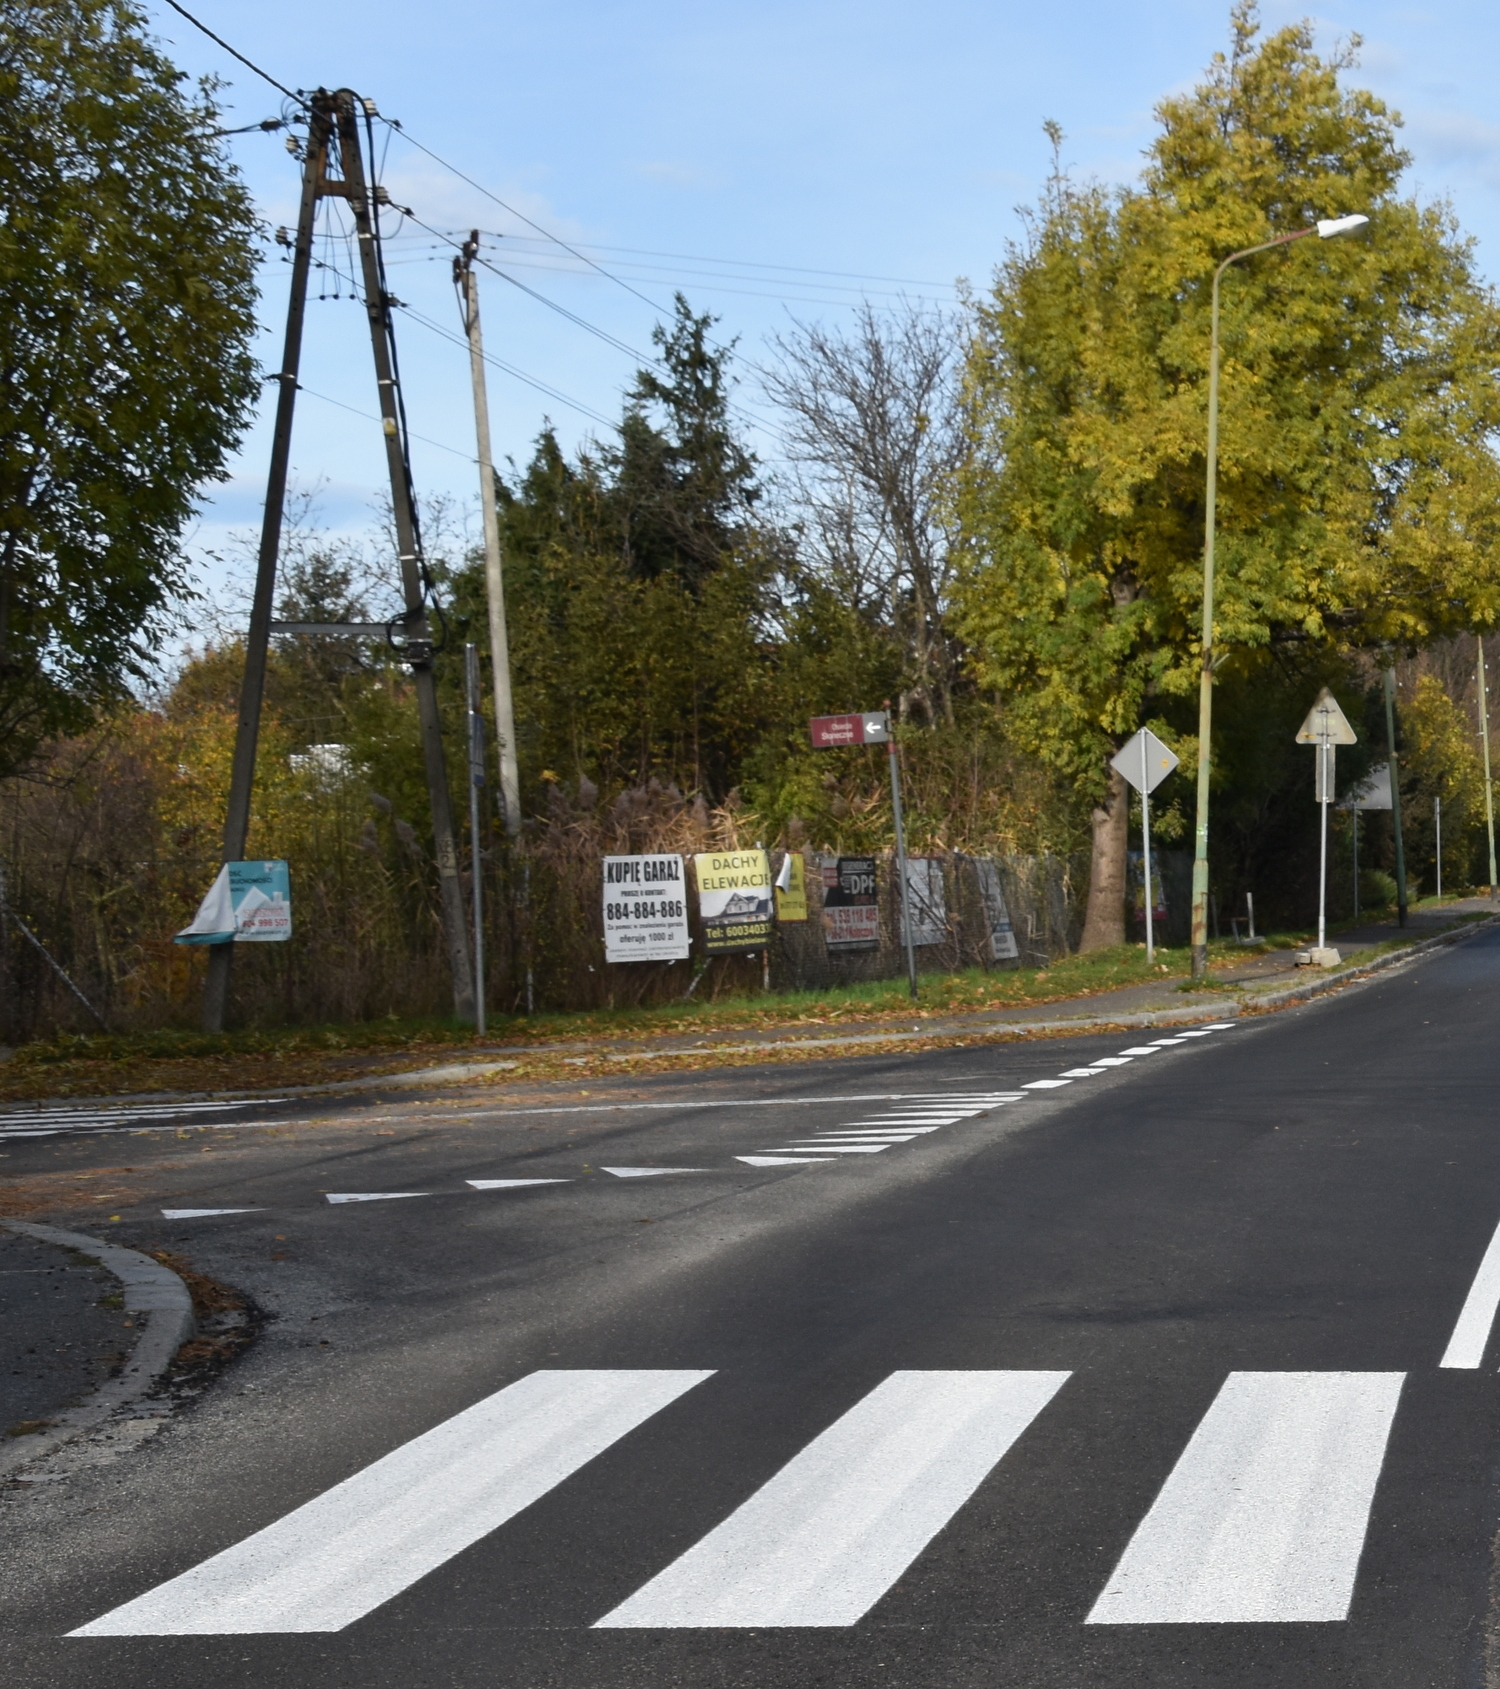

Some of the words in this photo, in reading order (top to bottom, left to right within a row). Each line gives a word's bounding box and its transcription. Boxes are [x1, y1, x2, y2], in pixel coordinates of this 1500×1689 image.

[607, 861, 641, 886] KUPIĘ
[643, 856, 680, 882] GARAŻ
[712, 856, 759, 871] DACHY
[702, 873, 770, 890] ELEWACJE
[851, 874, 875, 895] DPF
[606, 900, 683, 920] 884-884-886
[649, 932, 666, 943] 1000
[705, 928, 724, 939] Tel:
